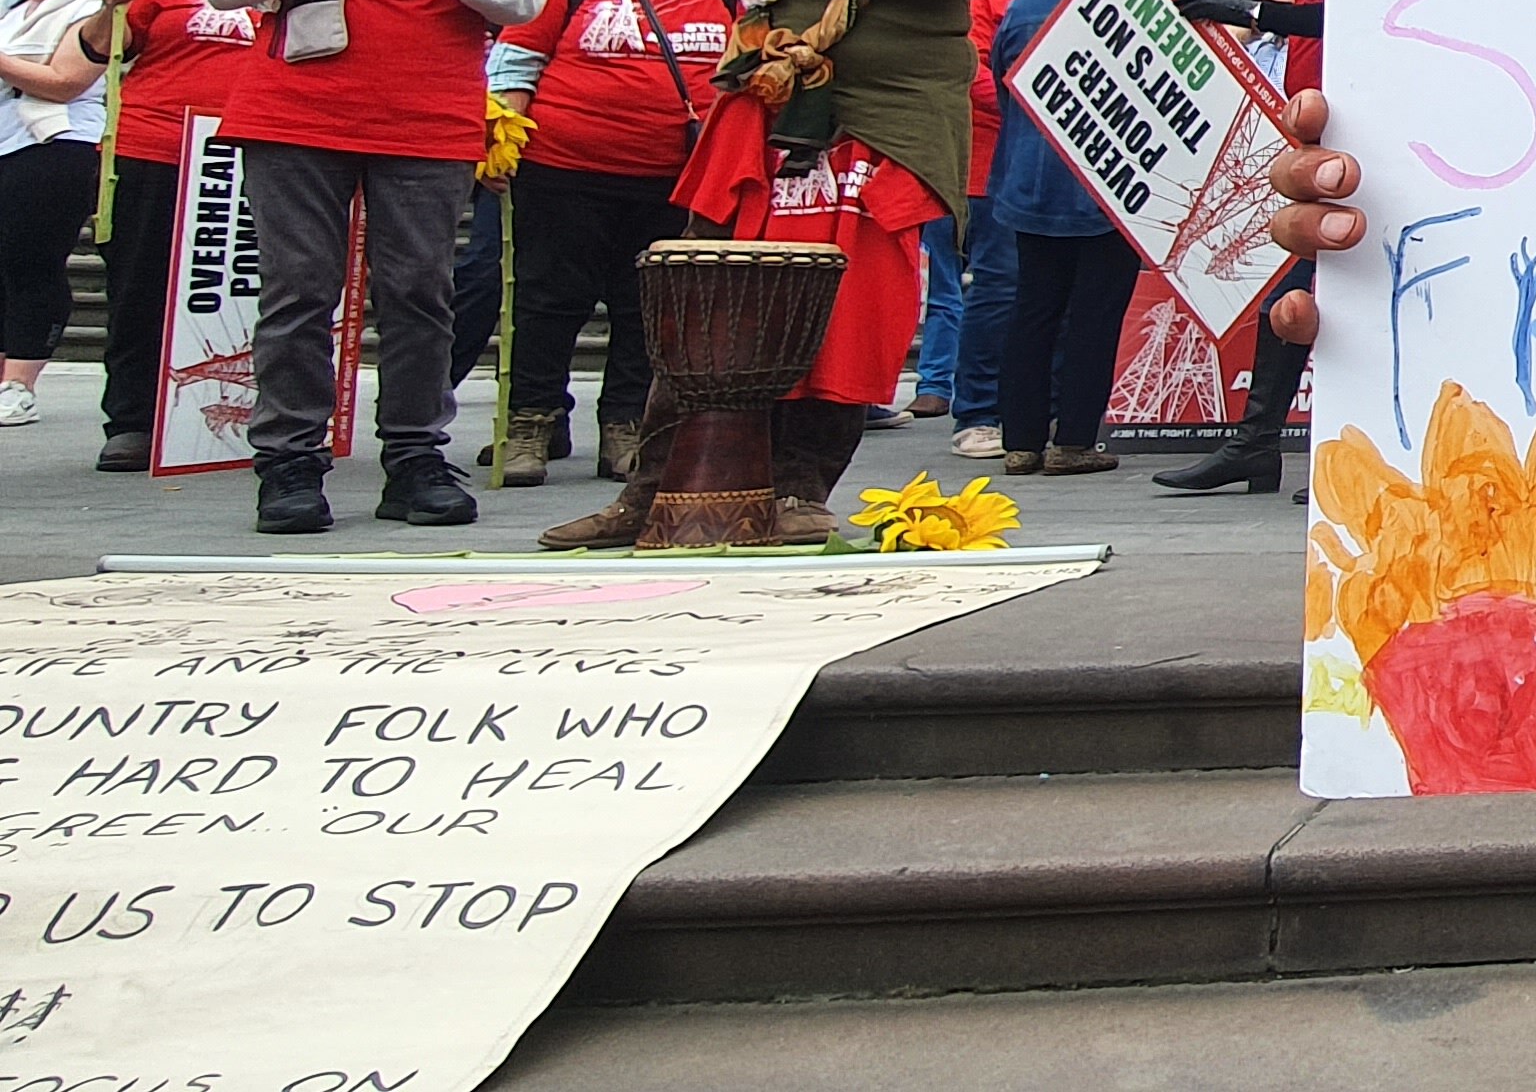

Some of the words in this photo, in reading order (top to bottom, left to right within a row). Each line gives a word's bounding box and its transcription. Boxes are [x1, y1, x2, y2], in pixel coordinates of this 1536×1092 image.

[1064, 50, 1168, 173] POWER?
[1126, 45, 1211, 155] THAT'S
[1031, 63, 1151, 215] OVERHEAD
[187, 138, 236, 314] OVERHEAD
[1137, 429, 1158, 438] THE
[1196, 428, 1223, 438] VISIT
[154, 655, 311, 677] AND
[340, 656, 450, 675] THE
[498, 659, 700, 677] LIVES
[324, 702, 518, 746] FOLK
[556, 701, 709, 741] WHO
[53, 755, 278, 796] HARD
[321, 756, 416, 797] TO
[43, 885, 176, 944] US
[212, 882, 315, 932] TO
[347, 880, 578, 933] STOP
